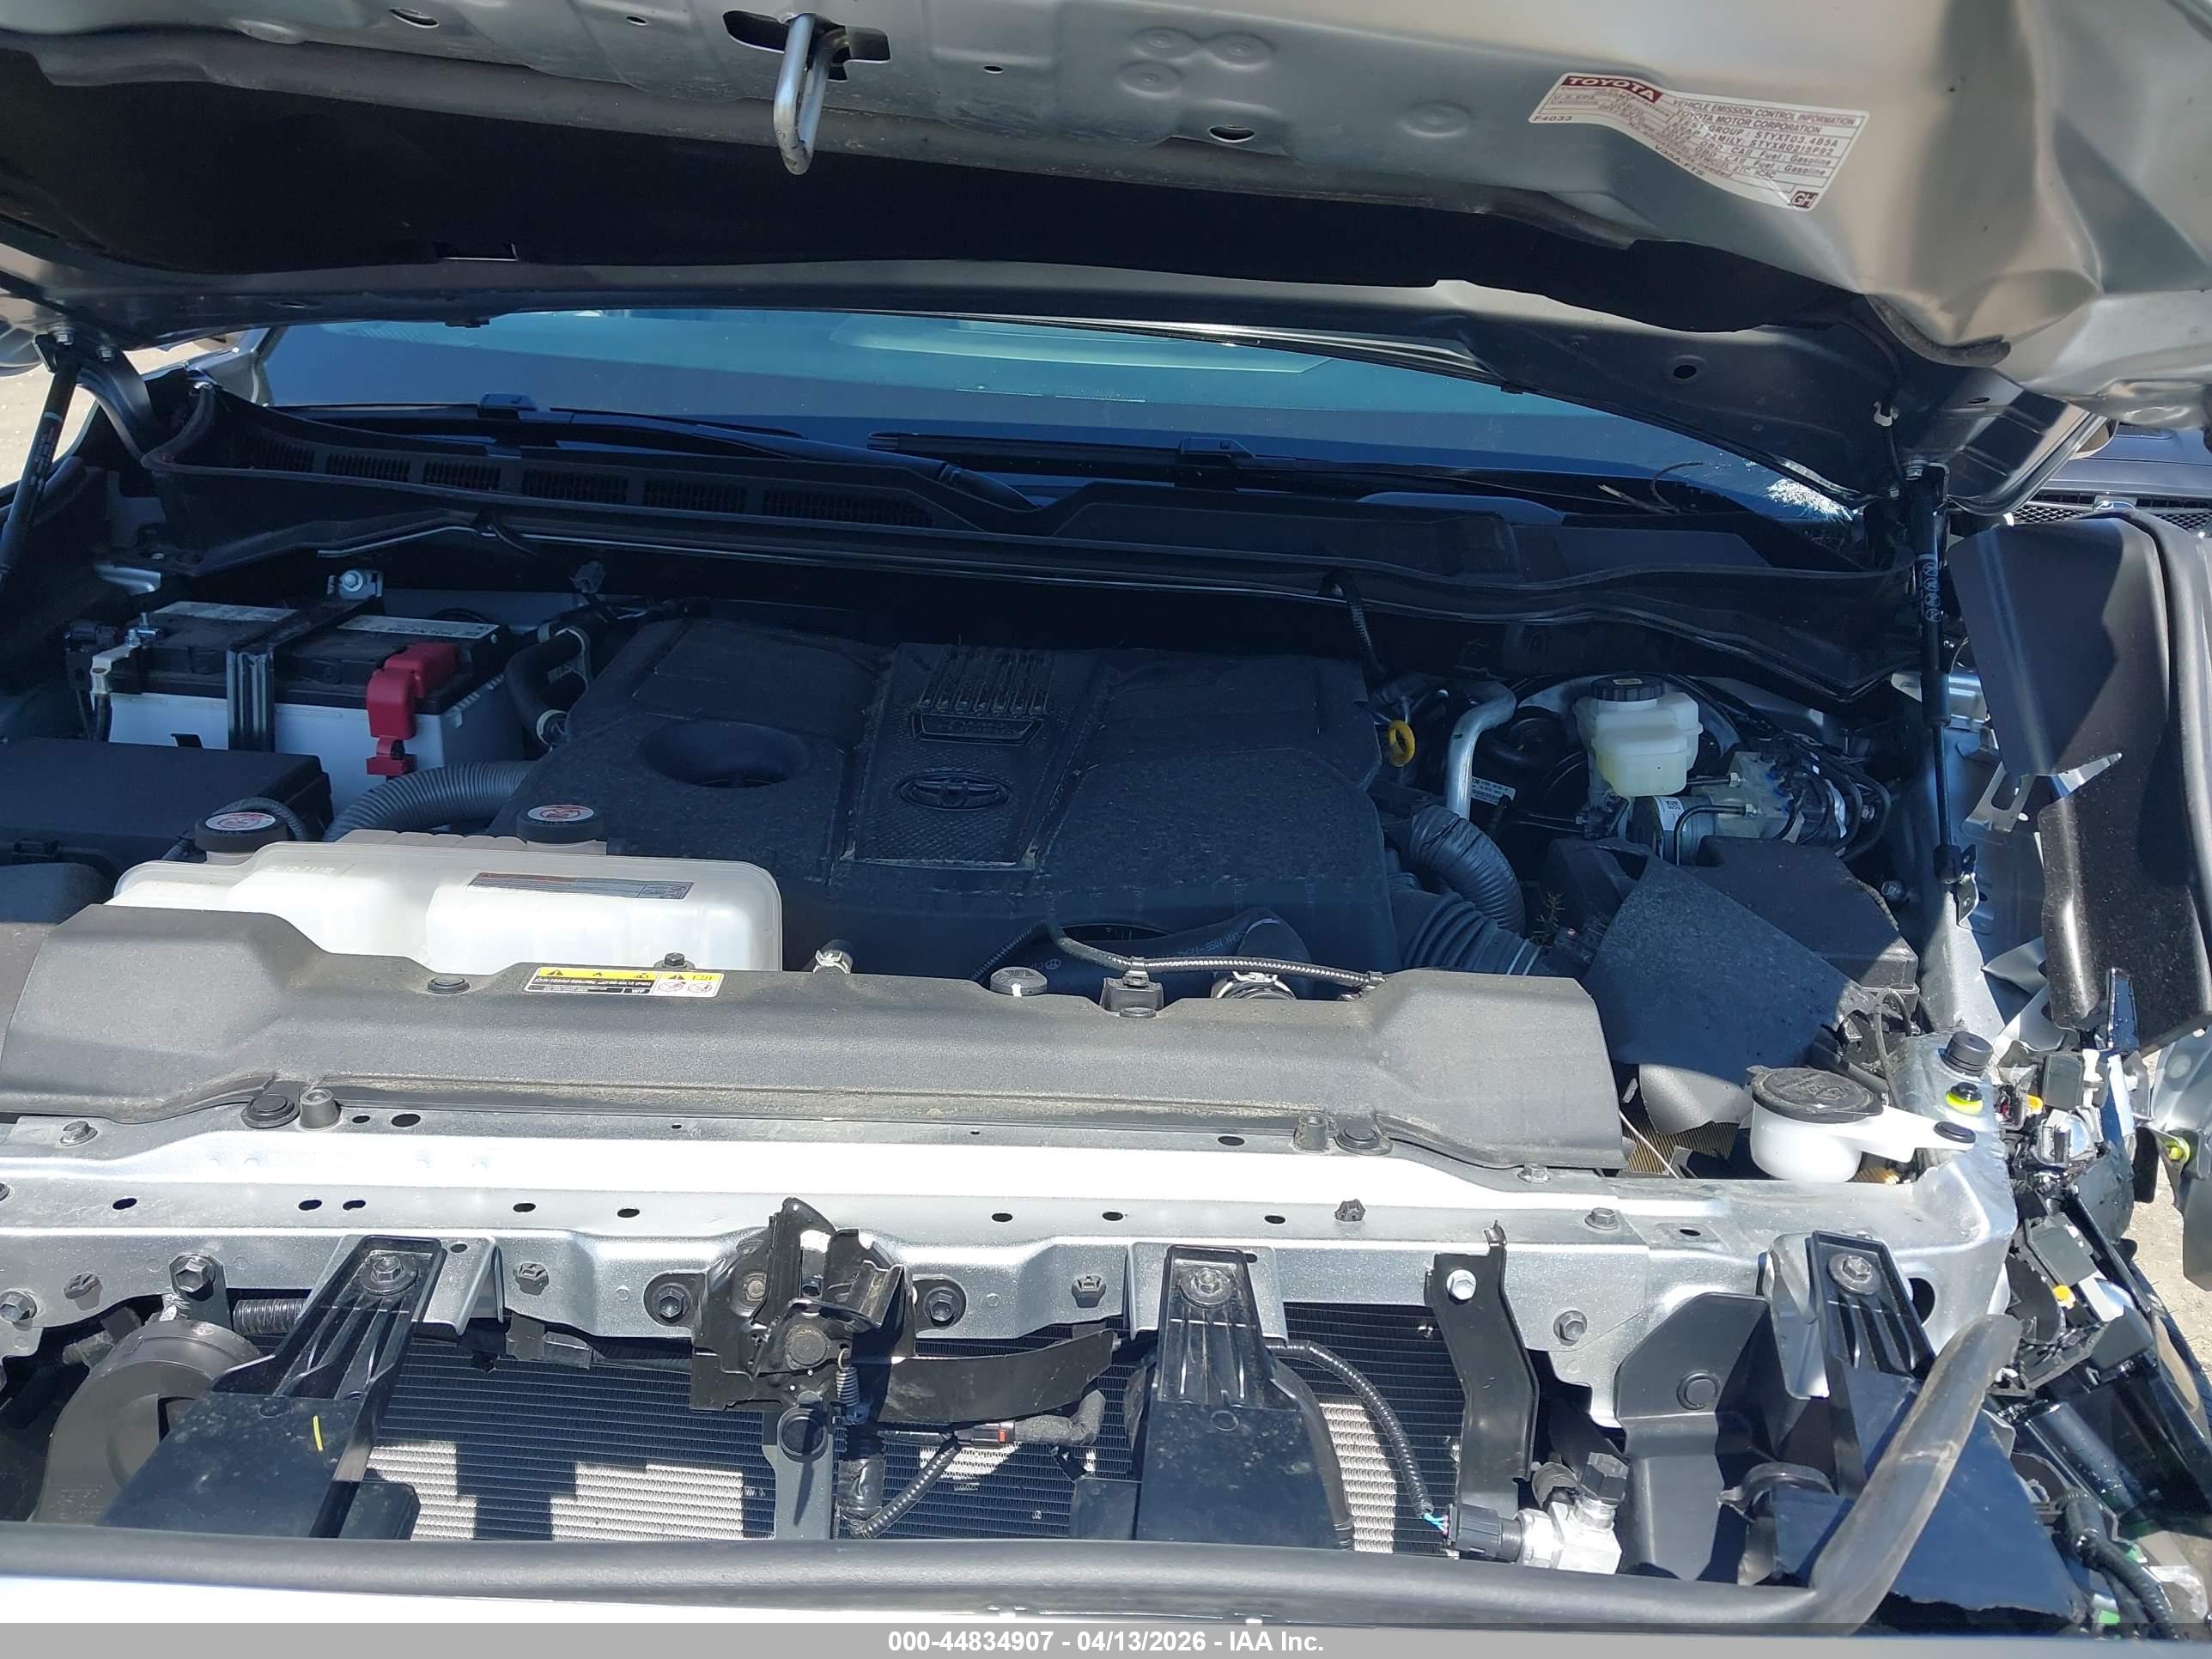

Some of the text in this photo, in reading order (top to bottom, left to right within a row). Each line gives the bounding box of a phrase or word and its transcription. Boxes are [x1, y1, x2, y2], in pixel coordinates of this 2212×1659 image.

[1569, 77, 1655, 100] TOYOTA
[1674, 99, 1711, 112] VEHICLE
[1711, 103, 1753, 117] EMISSION
[1755, 109, 1796, 121] CONTROL
[1799, 113, 1856, 126] INFORMATION
[1676, 109, 1713, 123] TOYOTA
[1716, 116, 1752, 128] MOTOR
[1753, 120, 1822, 135] CORPORATION
[1678, 118, 1705, 131] TEST
[1790, 155, 1832, 167] Gasoline
[1784, 164, 1826, 177] Gasoline
[1792, 191, 1817, 207] GH
